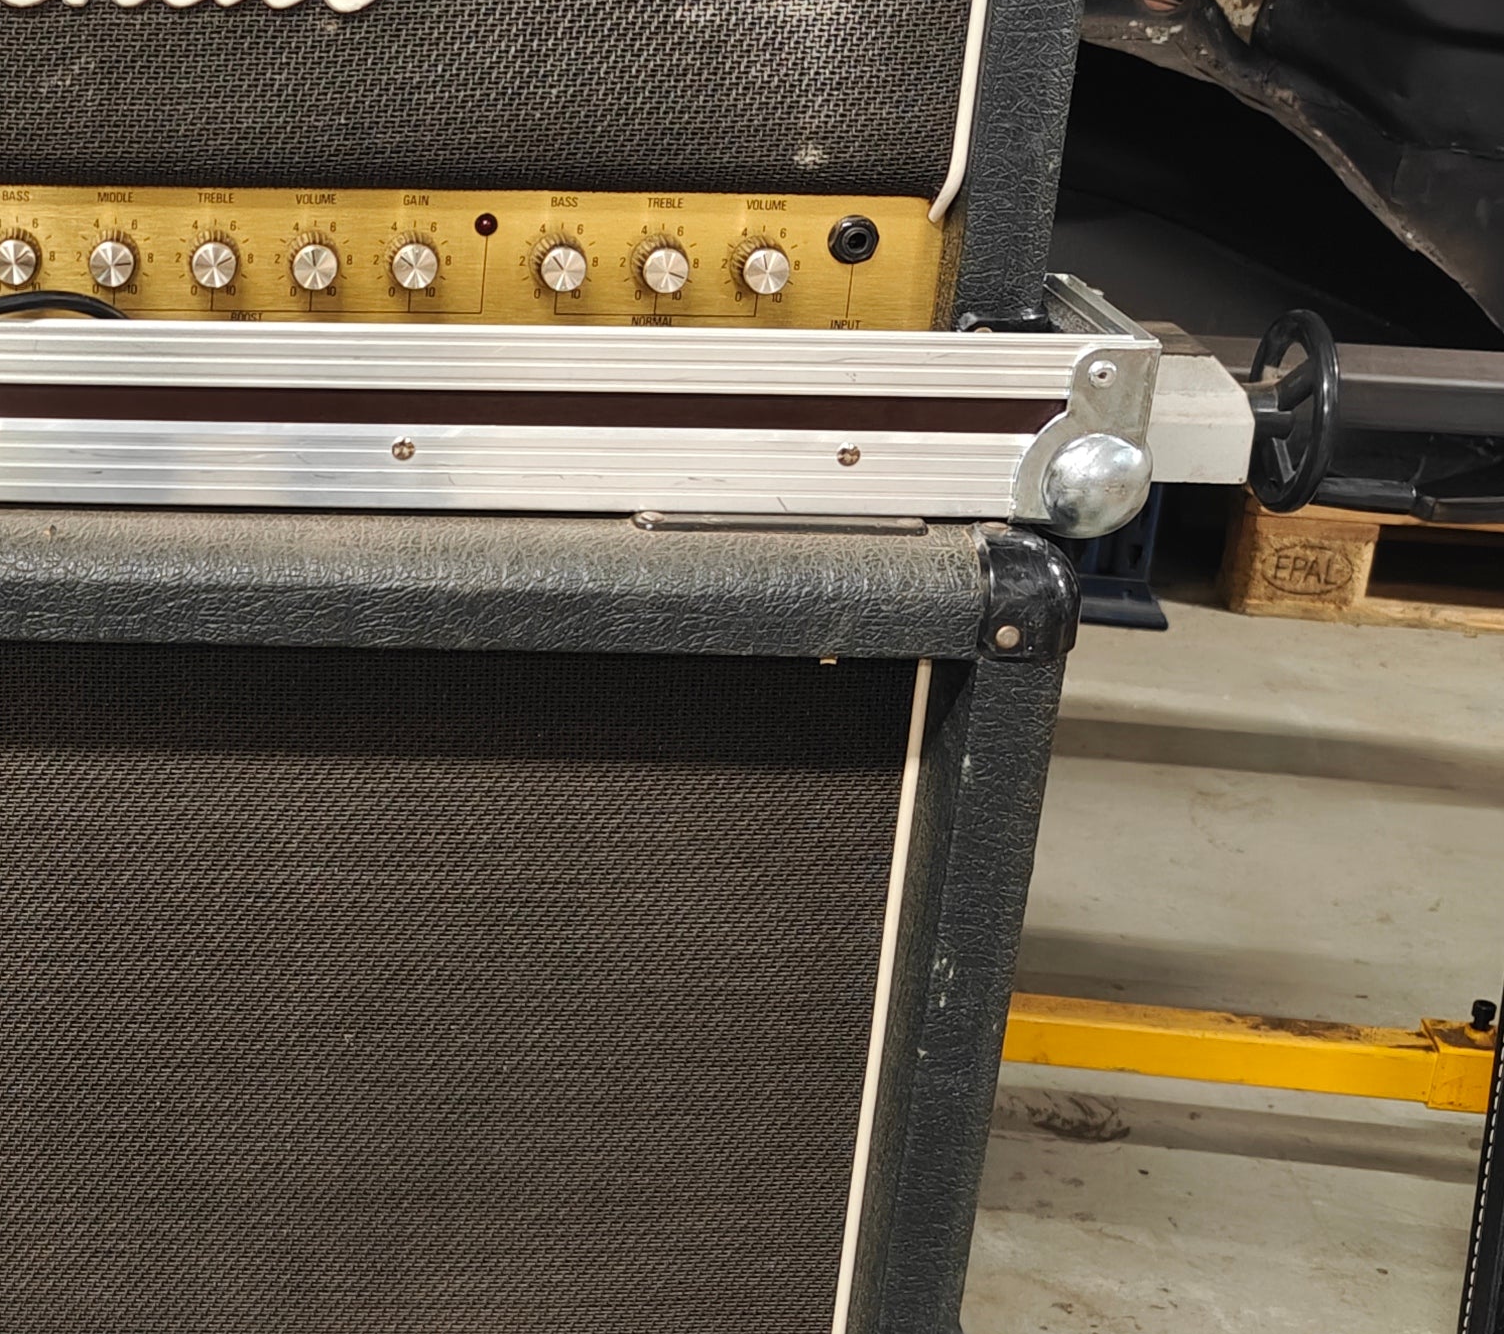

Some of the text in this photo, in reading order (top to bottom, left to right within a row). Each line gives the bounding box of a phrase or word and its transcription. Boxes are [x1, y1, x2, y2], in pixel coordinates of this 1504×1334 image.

[3, 191, 30, 201] BASS
[98, 192, 133, 203] MIDDLE
[198, 193, 234, 203] TREBLE
[296, 194, 336, 204] VOLUME
[403, 195, 429, 206] GAIN
[551, 197, 578, 207] BASS
[648, 198, 684, 208] TREBLE
[747, 200, 787, 210] VOLUME
[32, 219, 38, 228] 6
[93, 219, 99, 228] 4
[131, 219, 137, 229] 6
[192, 220, 198, 229] 4
[230, 221, 236, 230] 6
[293, 222, 299, 231] 4
[330, 222, 336, 232] 6
[391, 222, 397, 231] 4
[431, 222, 437, 232] 6
[540, 224, 546, 233] 4
[577, 224, 583, 234] 6
[641, 225, 647, 235] 4
[677, 226, 683, 236] 6
[742, 228, 748, 237] 4
[780, 228, 786, 238] 6
[49, 251, 55, 261] 8
[76, 251, 82, 261] 2
[148, 253, 153, 263] 8
[175, 253, 181, 262] 2
[248, 254, 253, 263] 8
[275, 254, 280, 263] 2
[347, 255, 352, 264] 8
[373, 255, 379, 264] 2
[446, 255, 451, 265] 8
[519, 257, 526, 266] 2
[592, 257, 598, 267] 8
[620, 257, 626, 266] 2
[693, 258, 699, 268] 8
[722, 260, 728, 269] 2
[794, 261, 800, 270] 8
[32, 282, 40, 290] 10
[93, 284, 98, 294] 0
[127, 284, 137, 294] 10
[191, 285, 197, 295] 0
[226, 286, 235, 295] 10
[290, 287, 296, 296] 0
[327, 287, 336, 296] 10
[389, 287, 395, 297] 0
[425, 287, 435, 296] 10
[534, 288, 540, 298] 0
[571, 289, 581, 299] 10
[635, 290, 641, 300] 0
[672, 290, 681, 300] 10
[735, 292, 742, 302] 0
[772, 292, 782, 302] 10
[231, 312, 263, 321] BOOST
[632, 317, 673, 326] NORMAL
[830, 320, 861, 329] INPUT
[1273, 553, 1336, 587] EPAL
